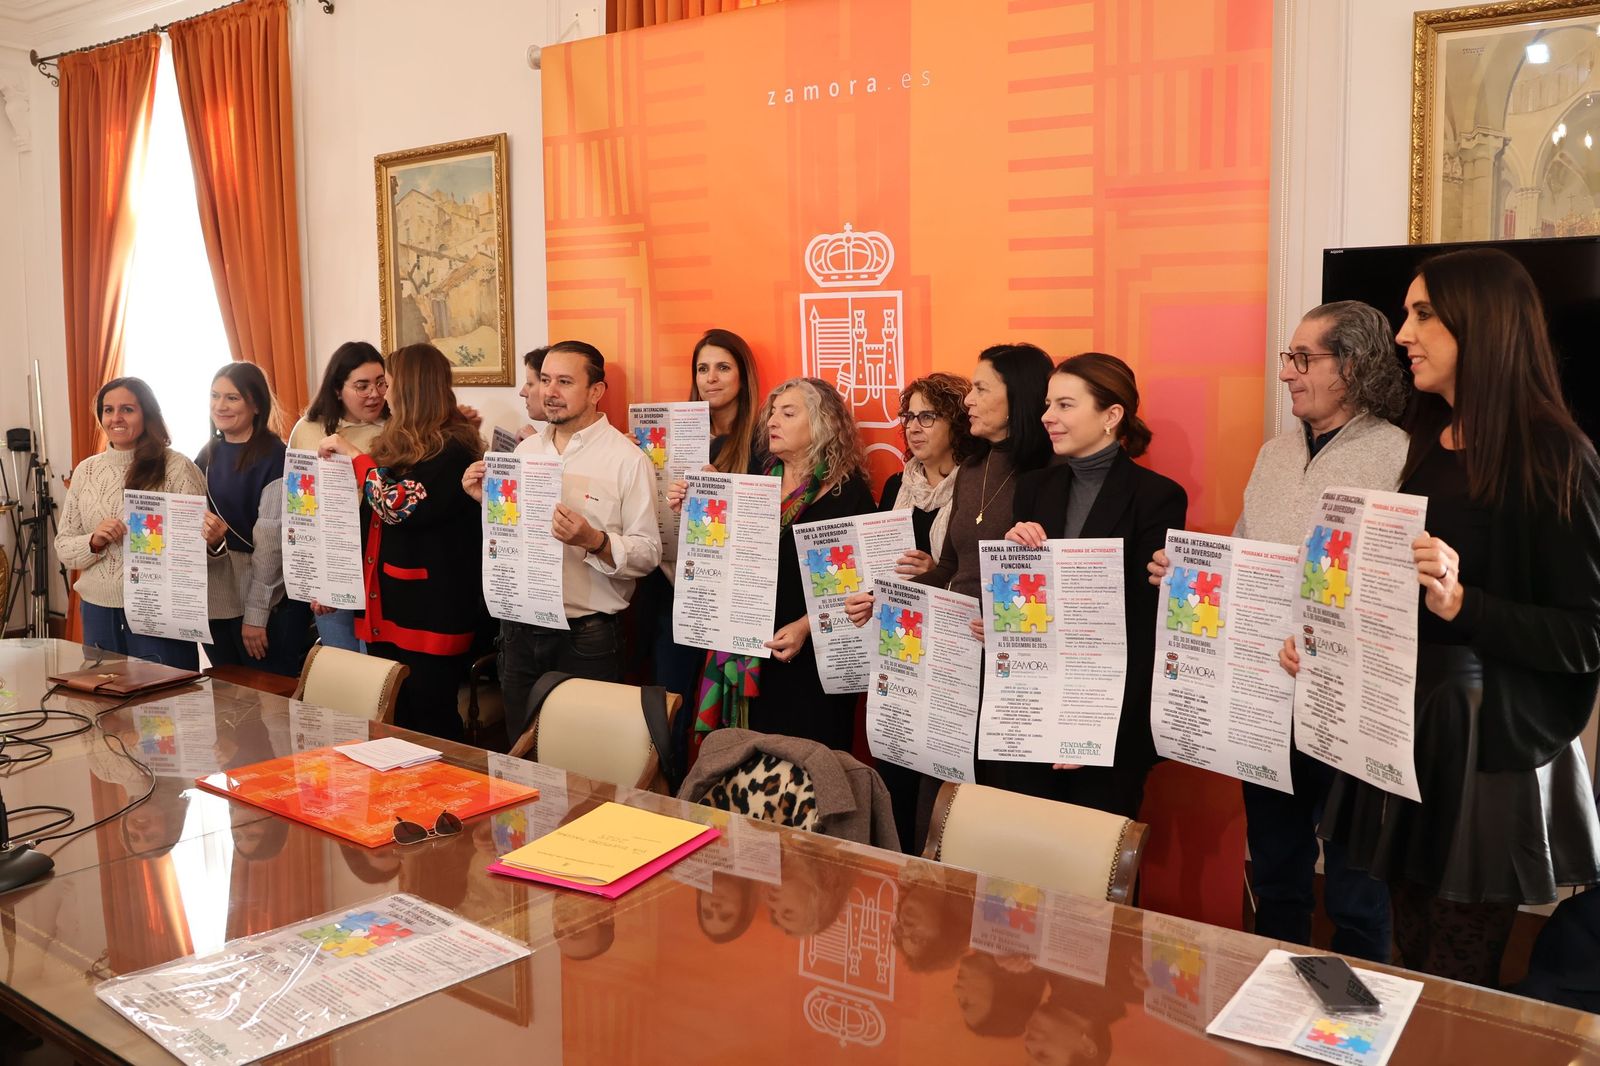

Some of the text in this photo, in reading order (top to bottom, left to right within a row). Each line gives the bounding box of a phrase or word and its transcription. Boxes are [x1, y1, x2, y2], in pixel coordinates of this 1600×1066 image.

[817, 521, 854, 531] INTERNACIONAL
[819, 530, 847, 538] DIVERSIDAD
[813, 538, 840, 546] FUNCIONAL
[1168, 536, 1231, 552] SEMANA INTERNACIONAL
[1191, 548, 1222, 559] DIVERSIDAD
[1183, 558, 1212, 567] FUNCIONAL
[696, 567, 721, 577] ZAMORA
[874, 579, 926, 595] SEMANA INTERNACIONAL
[894, 590, 920, 600] DIVERSIDAD
[888, 596, 912, 606] FUNCIONAL
[1317, 637, 1348, 656] ZAMORA
[1011, 661, 1049, 671] ZAMORA
[1180, 662, 1216, 679] ZAMORA
[890, 683, 918, 697] ZAMORA
[1237, 767, 1279, 782] CAJA RURAL
[414, 903, 454, 927] INTERNACIONAL
